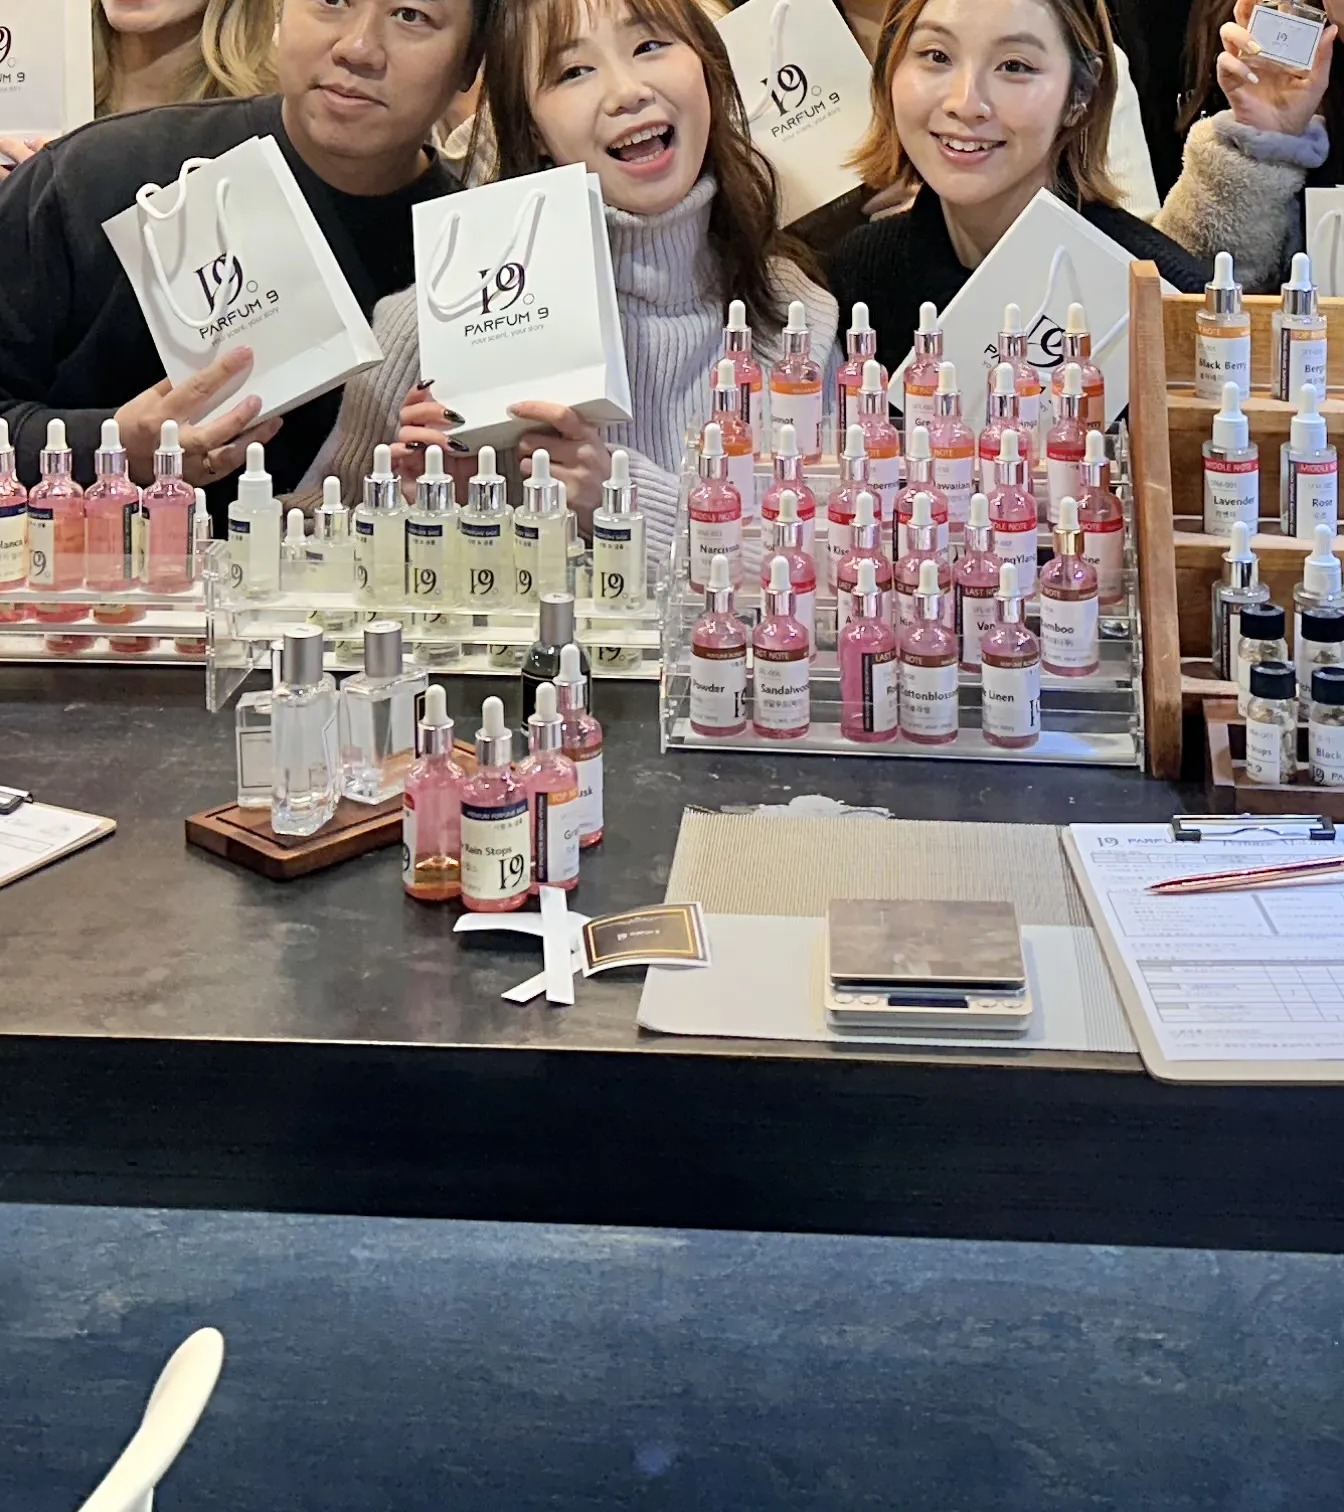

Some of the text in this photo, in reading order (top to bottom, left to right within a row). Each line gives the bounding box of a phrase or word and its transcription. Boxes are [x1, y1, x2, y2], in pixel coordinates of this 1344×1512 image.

[16, 71, 26, 83] 9
[770, 91, 841, 138] PARFUM 9
[199, 289, 279, 339] PARFUM 9
[464, 307, 550, 337] PARFUM 9
[1213, 495, 1255, 506] Lavender
[965, 586, 982, 597] LAST
[1044, 589, 1063, 598] NOTE
[769, 648, 791, 660] NOTE
[875, 651, 892, 662] LAST
[904, 654, 923, 666] NOTE
[988, 692, 1015, 703] Linen
[1316, 748, 1342, 760] Black
[464, 844, 513, 857] Rain Stops
